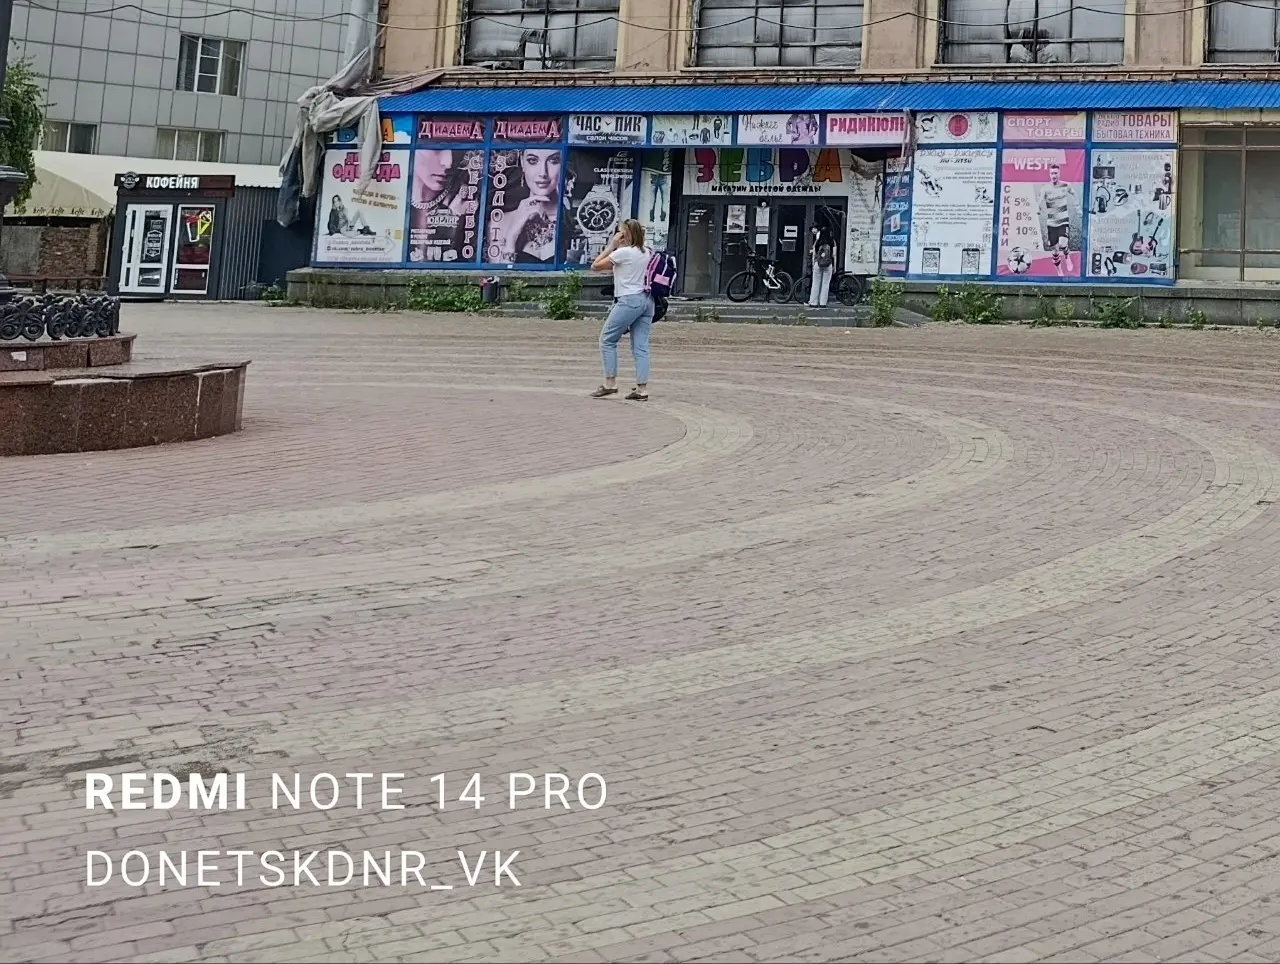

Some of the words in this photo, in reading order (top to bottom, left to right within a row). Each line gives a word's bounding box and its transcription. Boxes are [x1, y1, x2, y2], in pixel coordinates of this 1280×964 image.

[576, 116, 601, 132] ЧАС
[614, 116, 642, 132] ПИК
[1007, 118, 1051, 127] СПОРТ
[1121, 114, 1171, 127] ТОВАРЫ
[418, 121, 483, 139] ДИАДЕМА
[493, 121, 560, 138] ДИАДЕМА
[1026, 128, 1083, 137] ТОВАРЫ
[1096, 130, 1133, 139] БЫТОВАЯ
[1135, 130, 1171, 139] ТЕХНИКА
[694, 148, 843, 182] ЗЕБРА
[146, 174, 199, 189] КОФЕЙНЯ
[462, 155, 484, 259] СЕРЕБРО
[487, 155, 508, 259] ЗОЛОТО
[1014, 197, 1030, 207] 5%
[1001, 185, 1011, 246] СКИДКИ
[1016, 211, 1032, 221] 8%
[1016, 226, 1038, 235] 10%
